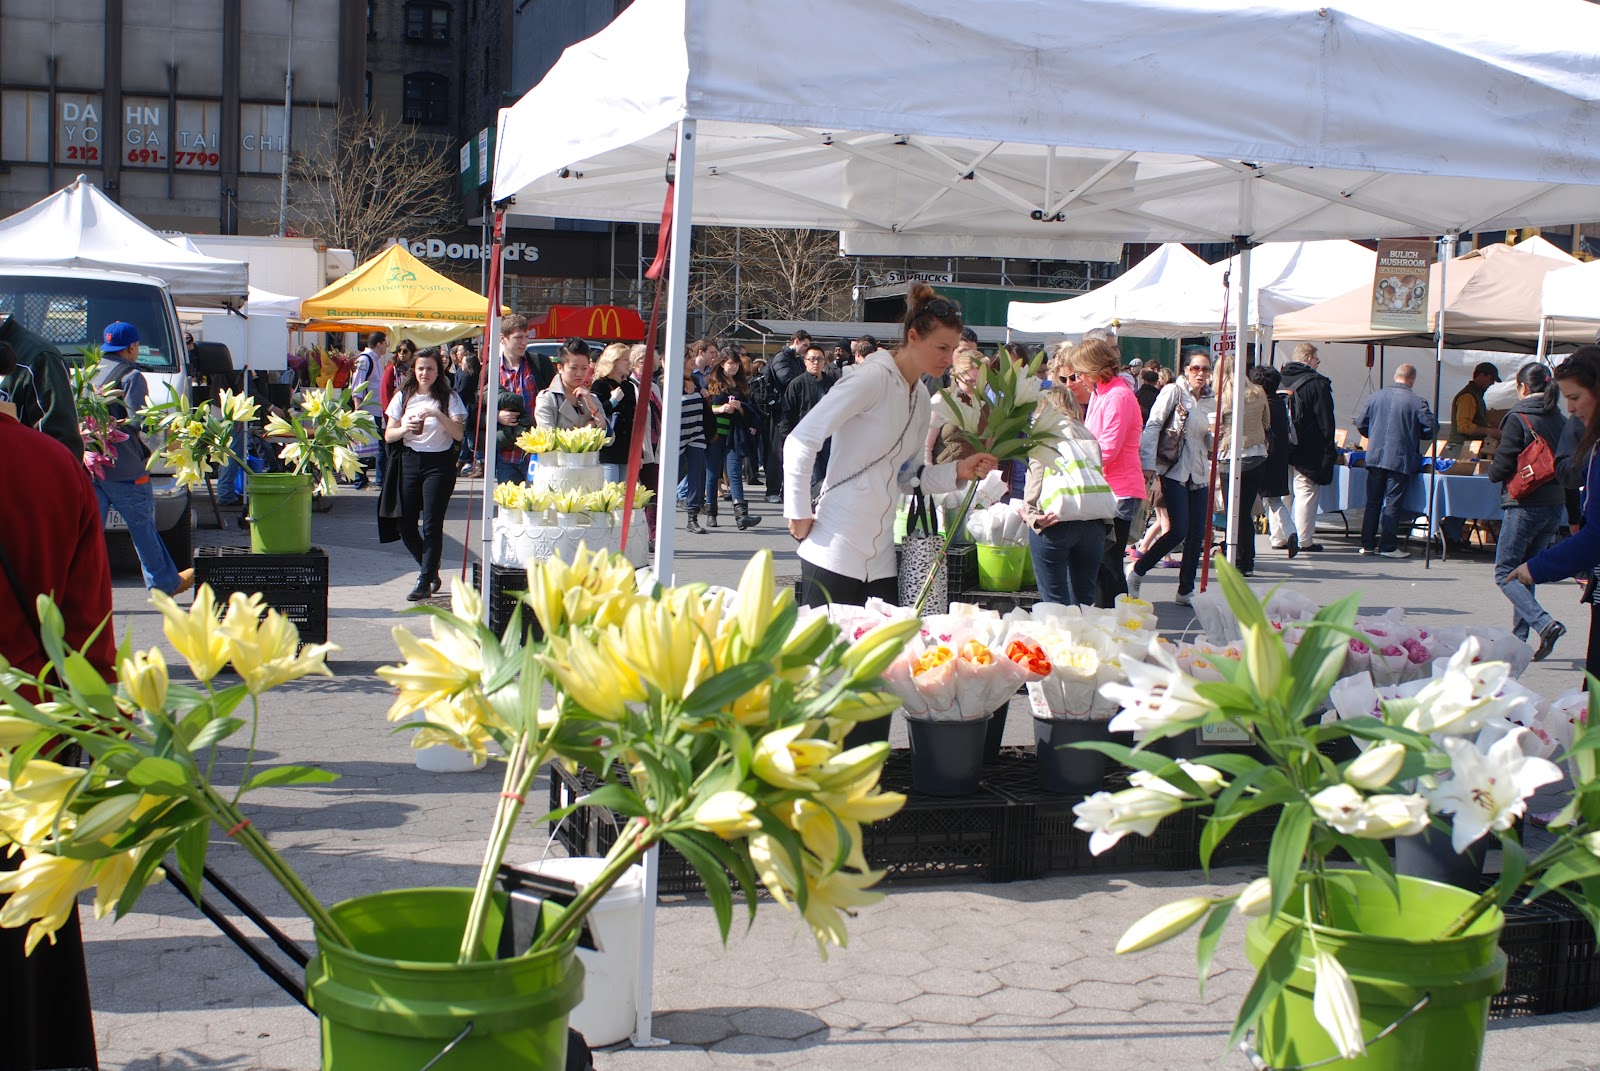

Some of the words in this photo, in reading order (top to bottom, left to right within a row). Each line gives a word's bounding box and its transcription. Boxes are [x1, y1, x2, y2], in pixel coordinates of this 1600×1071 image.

[63, 102, 98, 123] DA
[126, 106, 160, 126] HN
[64, 125, 99, 143] YO
[126, 128, 160, 146] GA
[180, 131, 216, 149] TAI
[242, 134, 284, 152] CHI
[67, 145, 98, 161] 212
[174, 150, 219, 167] 7799
[385, 237, 539, 262] McDonad's
[1390, 251, 1419, 259] BULICH
[1380, 259, 1426, 268] MUSHROOM
[351, 283, 412, 293] Hawthorne
[419, 283, 454, 293] Valley
[326, 308, 411, 319] Biodynamic
[415, 311, 425, 319] &
[430, 311, 486, 322] Organic
[1214, 341, 1236, 351] CIDE
